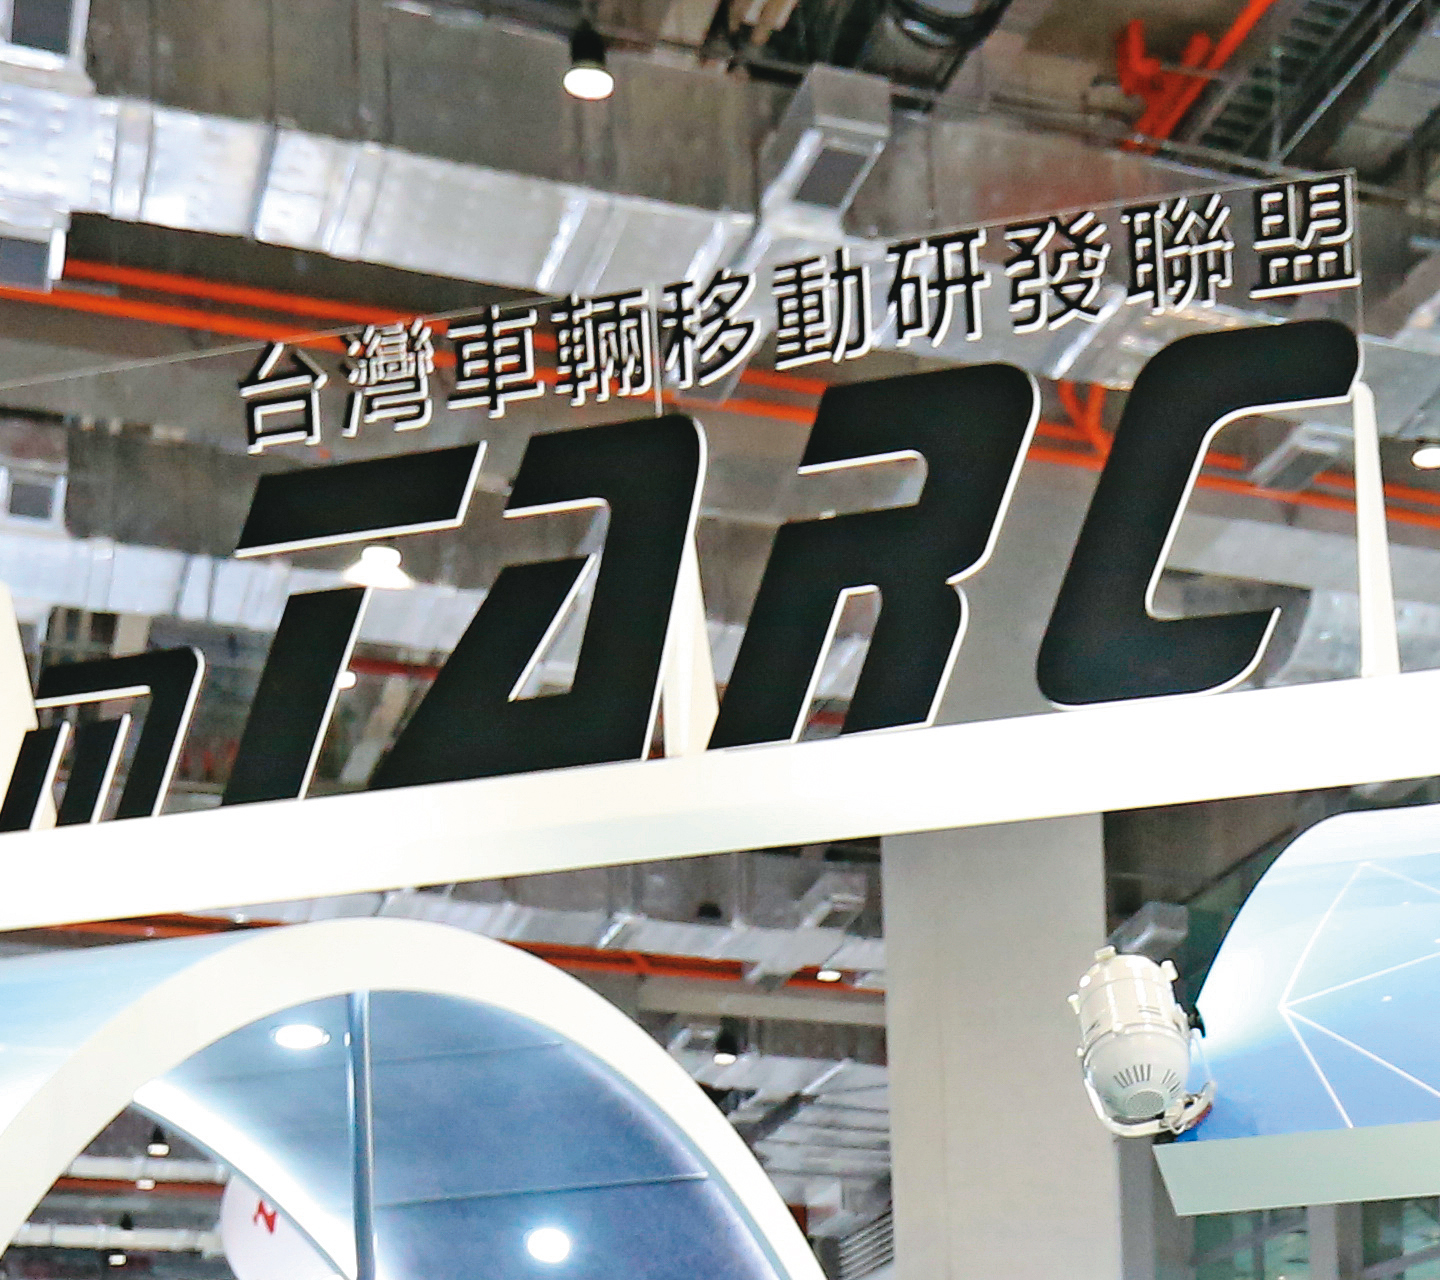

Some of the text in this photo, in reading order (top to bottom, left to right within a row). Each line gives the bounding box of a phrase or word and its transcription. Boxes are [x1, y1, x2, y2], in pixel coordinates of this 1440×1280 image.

[237, 172, 1362, 456] 台灣車輛移動研發聯盟
